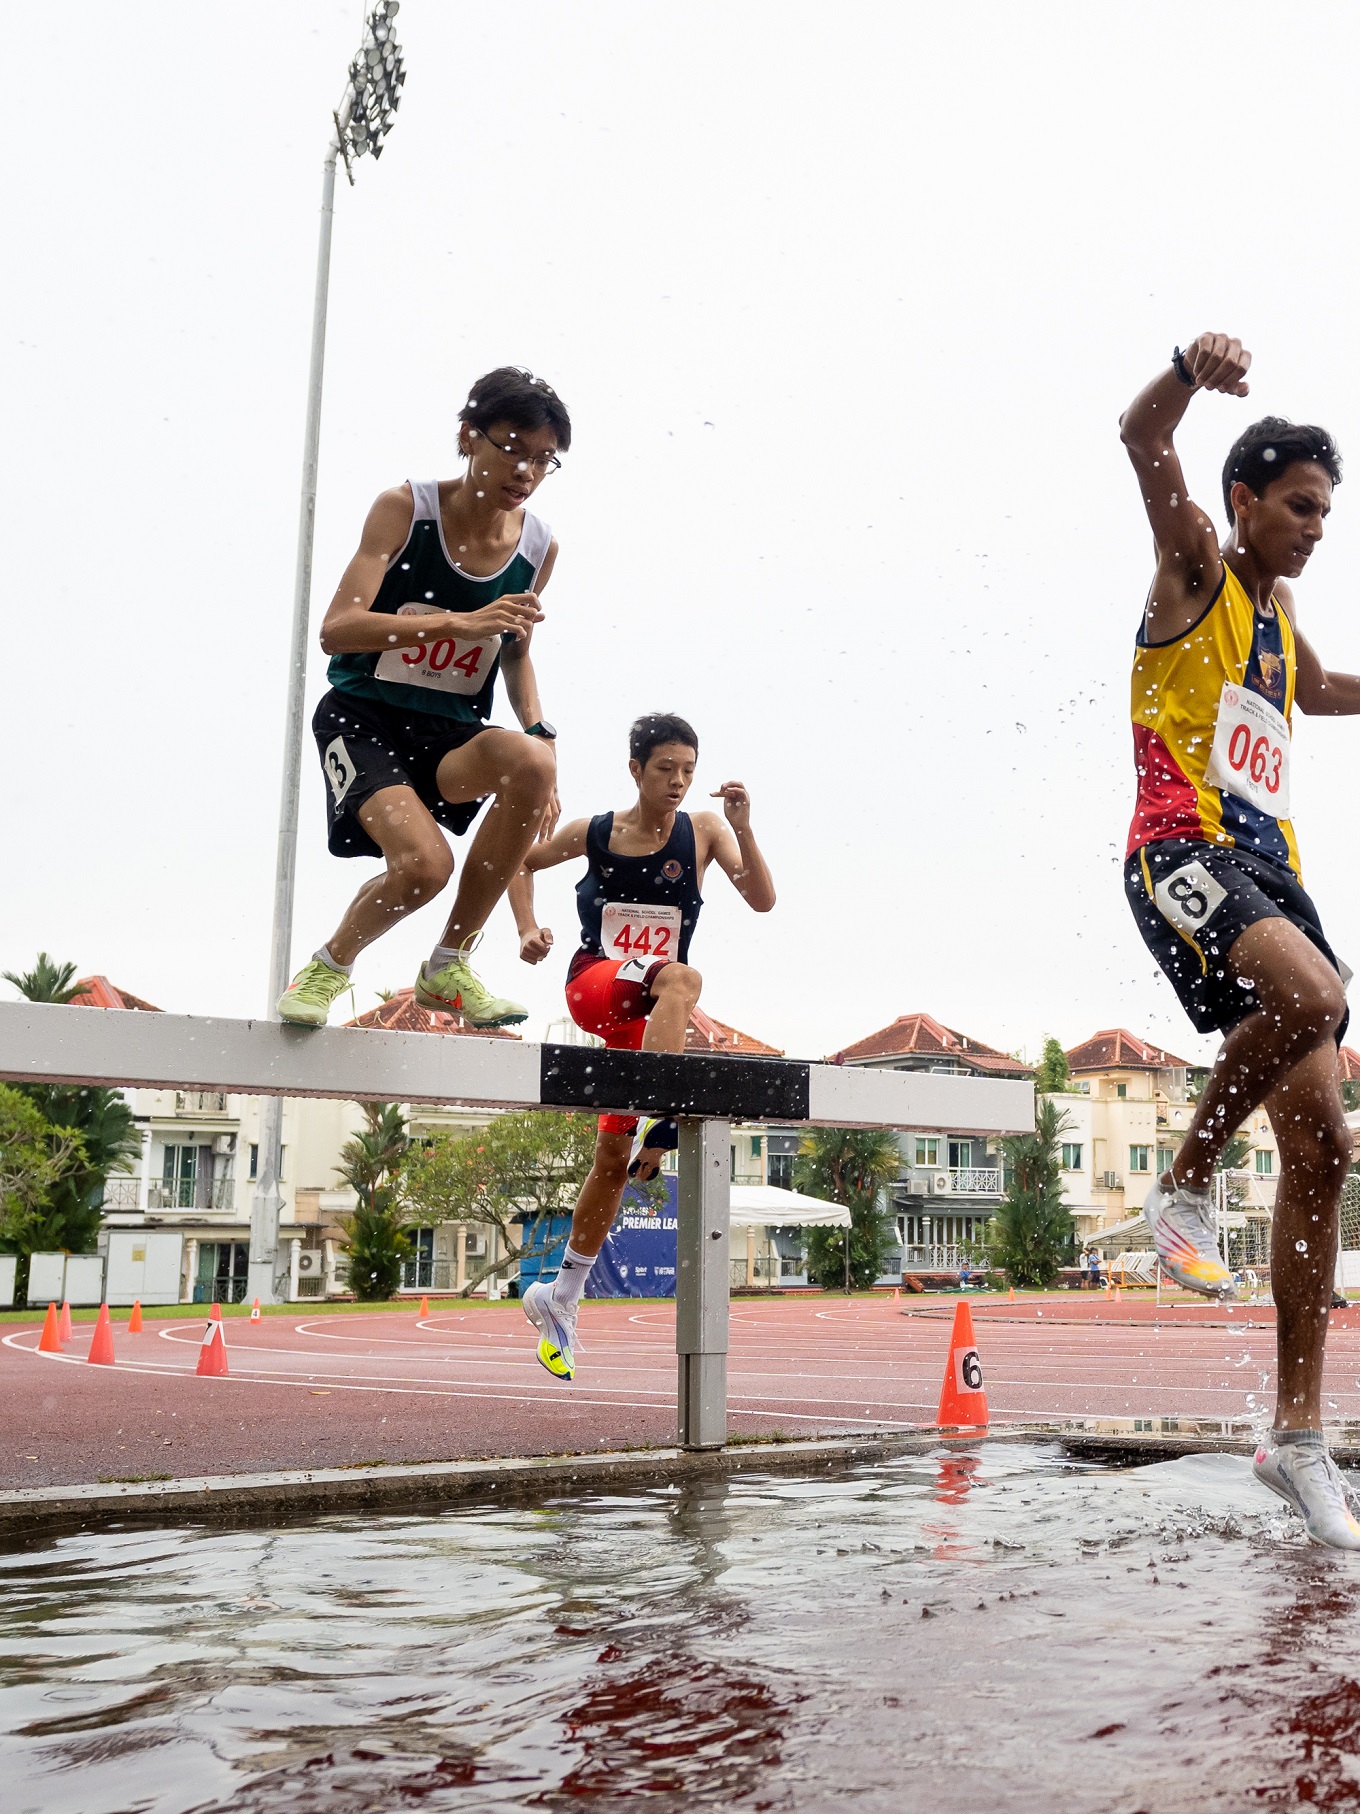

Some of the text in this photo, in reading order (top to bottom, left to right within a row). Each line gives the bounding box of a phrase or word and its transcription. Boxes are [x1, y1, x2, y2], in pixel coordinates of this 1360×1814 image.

[329, 751, 347, 790] 3
[1228, 723, 1283, 794] 063
[1167, 876, 1208, 919] 8
[613, 923, 671, 956] 442
[622, 1217, 662, 1230] PREMIER
[962, 1351, 982, 1389] 6
